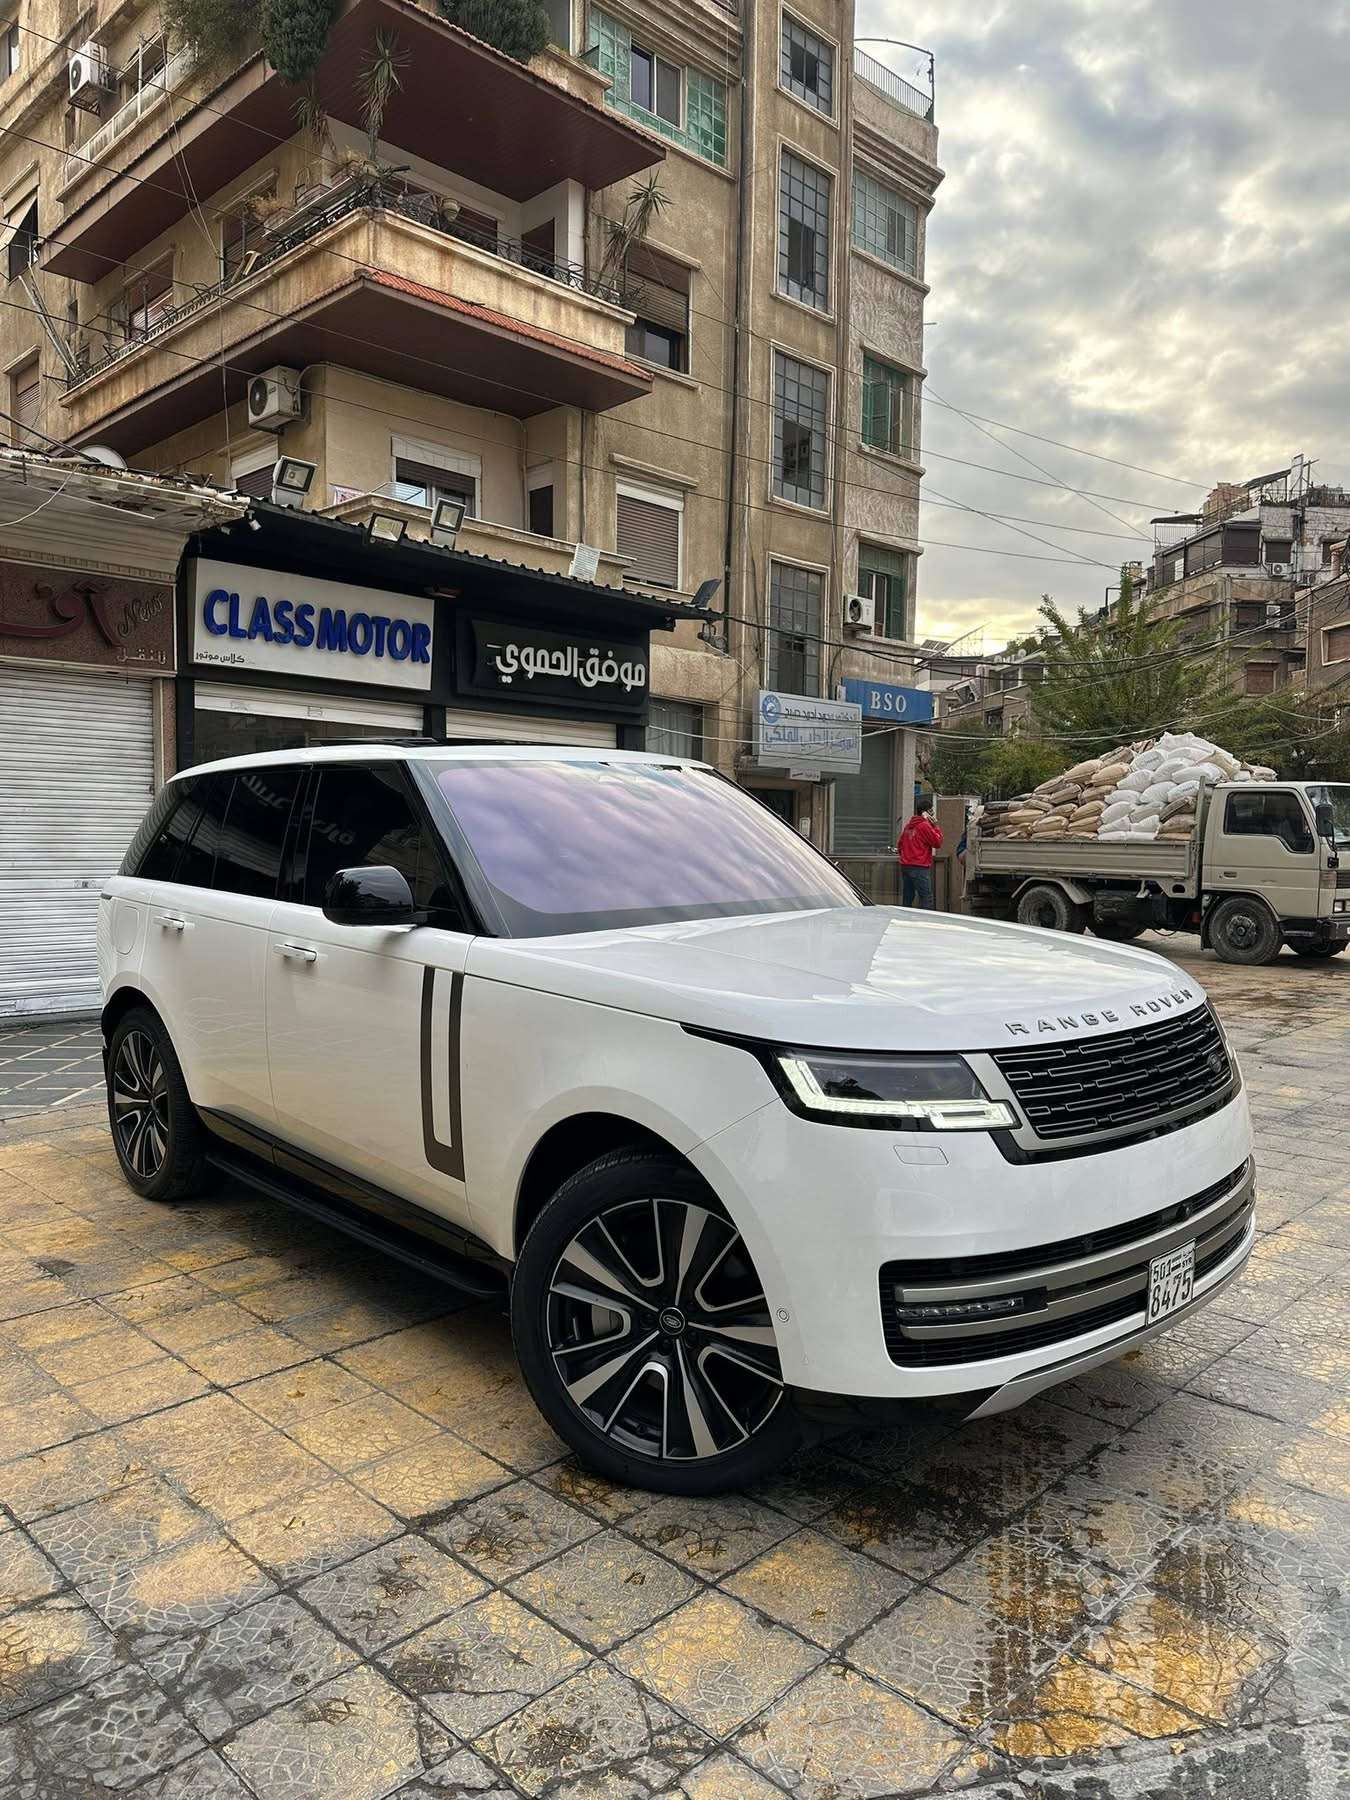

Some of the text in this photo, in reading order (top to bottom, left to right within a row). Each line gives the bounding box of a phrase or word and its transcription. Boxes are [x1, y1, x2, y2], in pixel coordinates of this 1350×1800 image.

[203, 588, 431, 664] CLASS MOTOR
[195, 651, 245, 664] كلاس موتور
[495, 643, 646, 692] موفق الحموي
[871, 691, 907, 713] BSO
[1004, 988, 1194, 1036] RANGE ROVER
[1151, 1270, 1191, 1318] 8475
